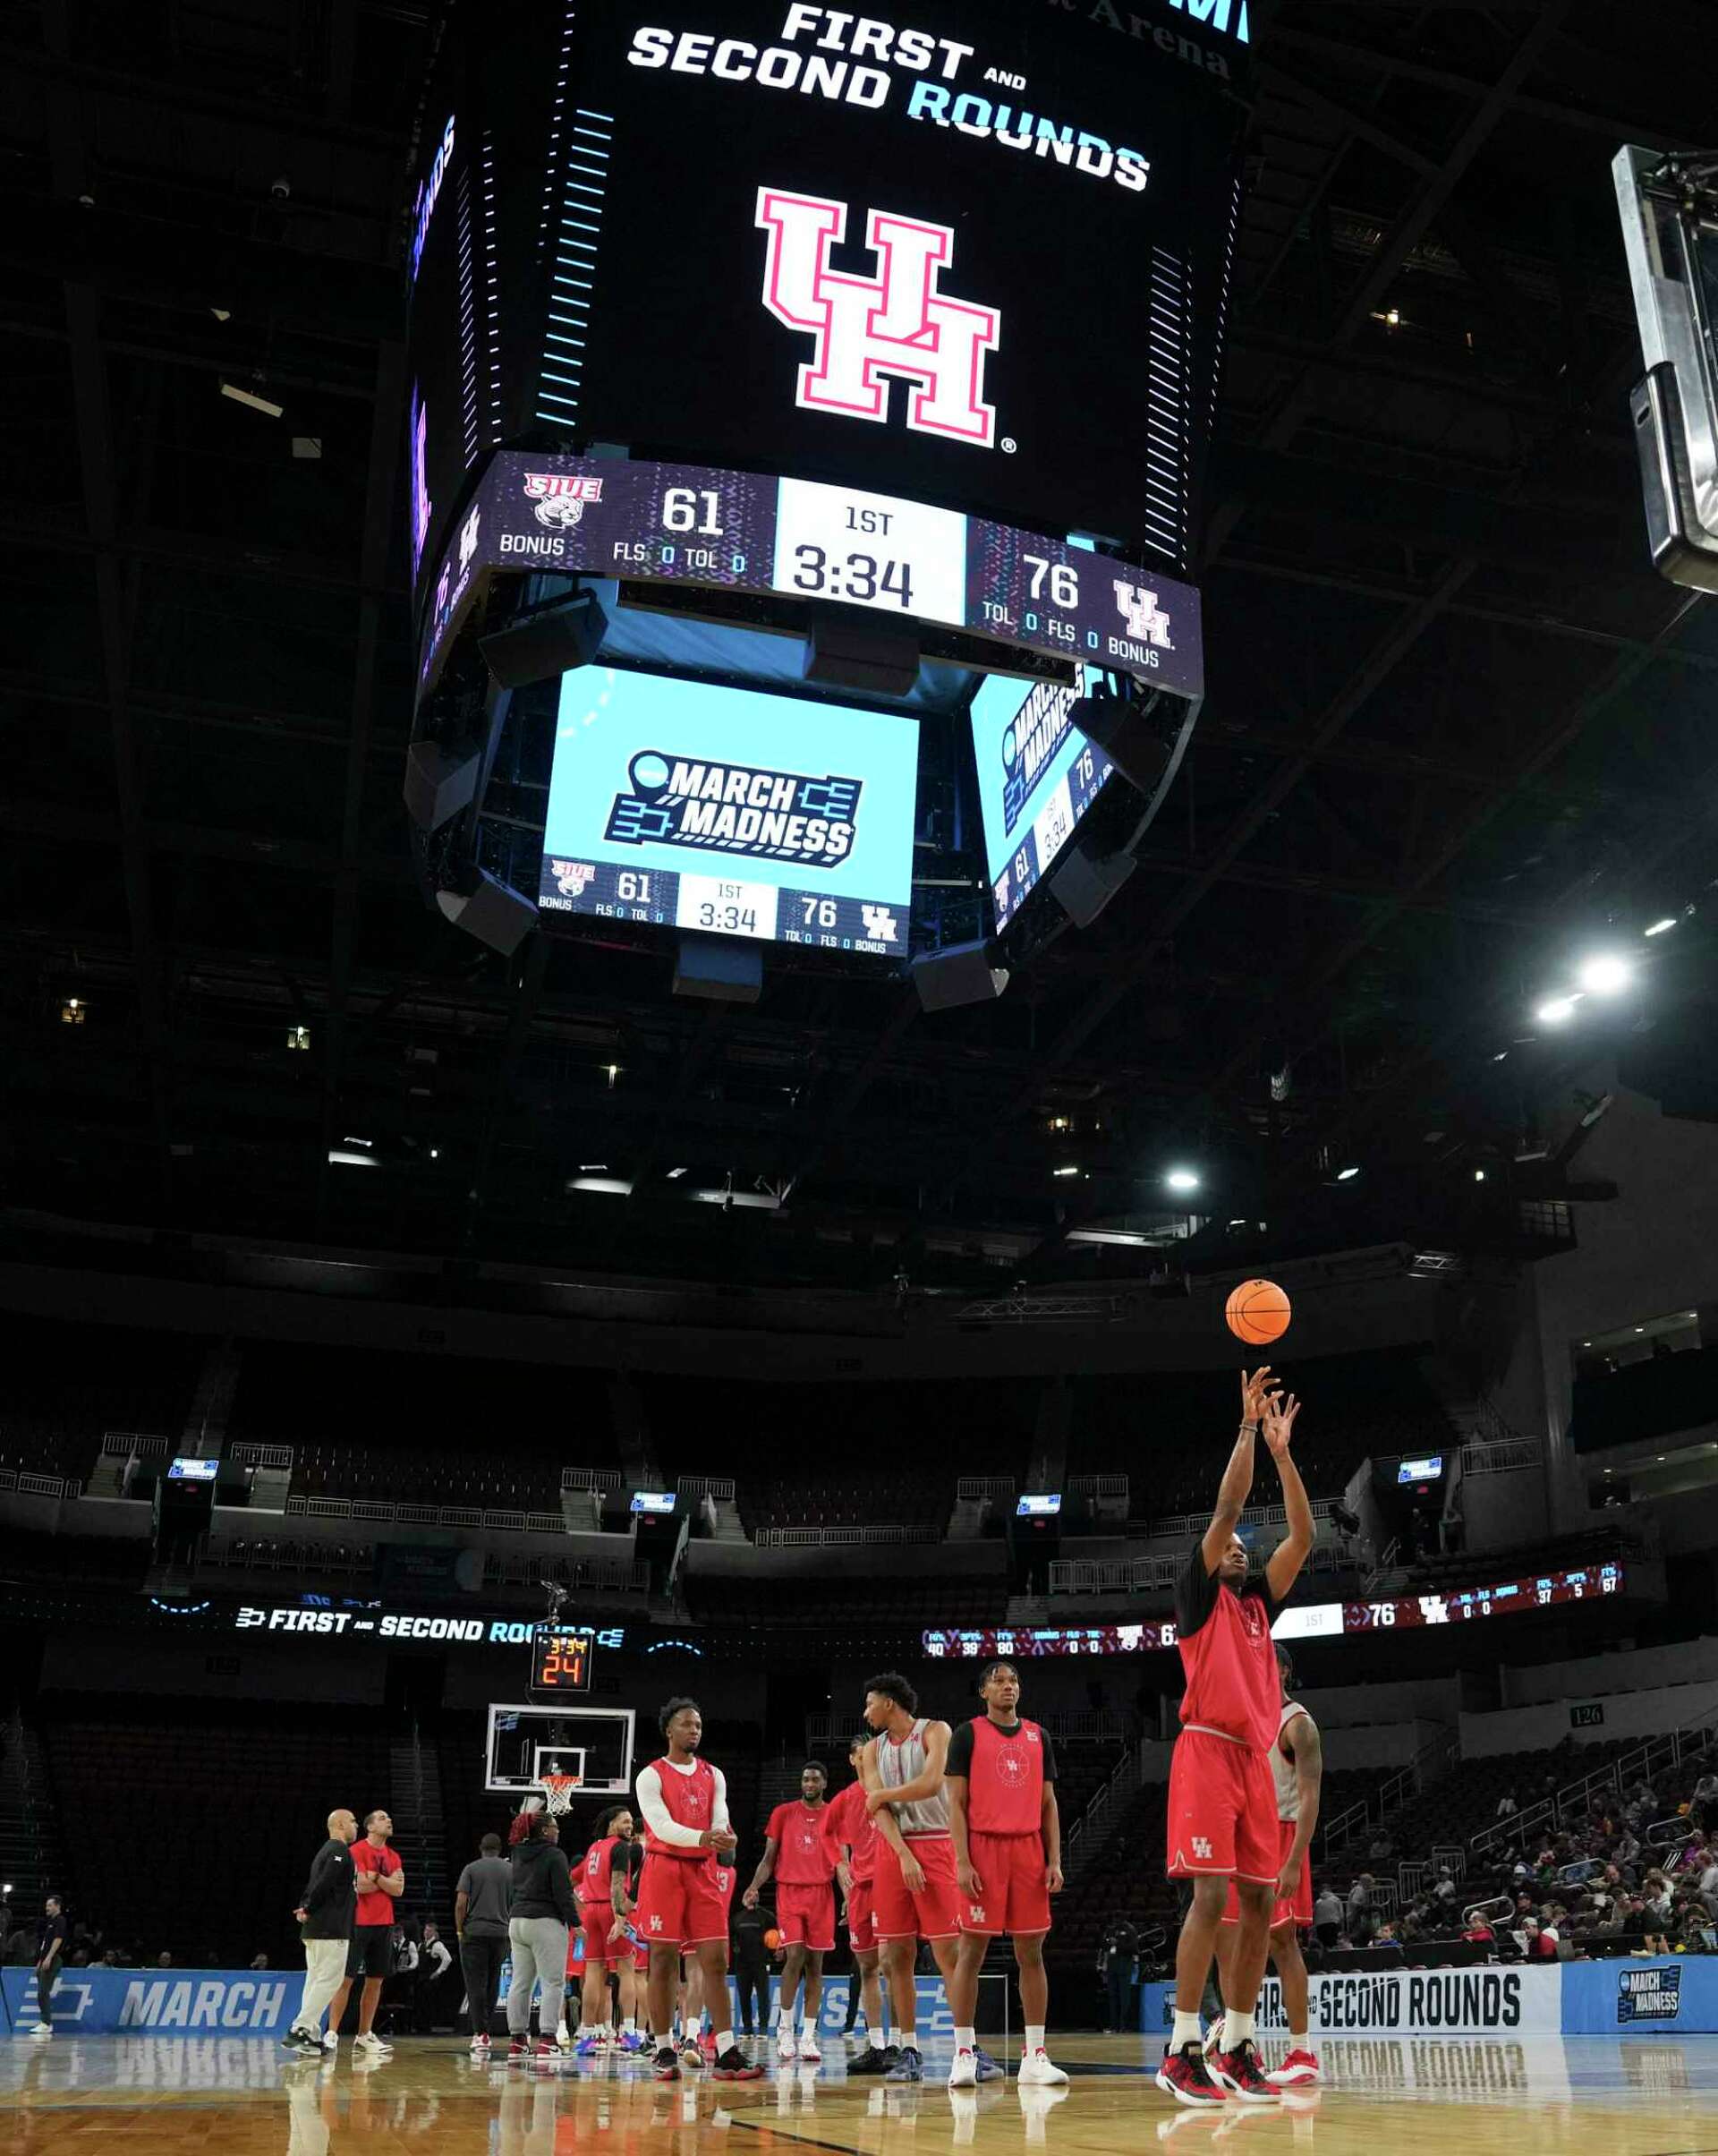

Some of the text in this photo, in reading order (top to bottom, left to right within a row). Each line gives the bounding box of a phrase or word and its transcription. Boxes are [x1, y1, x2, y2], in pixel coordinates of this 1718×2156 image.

[779, 2, 1026, 89] FIRST AND
[626, 27, 1152, 192] SECOND ROUNDS
[524, 473, 603, 502] SIUE
[663, 488, 723, 535] 61
[846, 506, 894, 536] 1ST
[499, 534, 566, 555] BONUS
[613, 542, 645, 561] FLS
[685, 548, 718, 568] TOL
[793, 544, 914, 608] 3:34
[1024, 554, 1079, 609] 76
[982, 601, 1013, 626] TOL
[1048, 619, 1076, 643] FLS
[1109, 636, 1160, 669] BONUS
[1076, 748, 1093, 789] 76
[668, 762, 796, 812] MARCH
[680, 799, 852, 856] MADNESS
[1015, 846, 1030, 883] 61
[618, 872, 651, 903] 61
[718, 882, 743, 899] 1ST
[539, 896, 573, 911] BONUS
[595, 903, 613, 917] FLS
[631, 908, 649, 922] TOL
[700, 902, 756, 933] 3:34
[802, 897, 837, 928] 76
[821, 934, 838, 948] FLS
[855, 939, 887, 955] BONUS
[1538, 1577, 1617, 1604] 37 5 67
[268, 1608, 351, 1633] FIRST
[379, 1615, 484, 1640] SECOND
[1305, 1614, 1323, 1627] 1ST
[1368, 1603, 1396, 1627] 76
[928, 1643, 944, 1656] 40
[962, 1642, 978, 1655] 39
[998, 1641, 1013, 1654] 80
[542, 1656, 580, 1683] 24
[1573, 1706, 1601, 1726] 126
[119, 1981, 286, 2027] MARCH
[1320, 1973, 1521, 2028] SECOND ROUNDS
[1635, 1990, 1679, 2013] MADNESS
